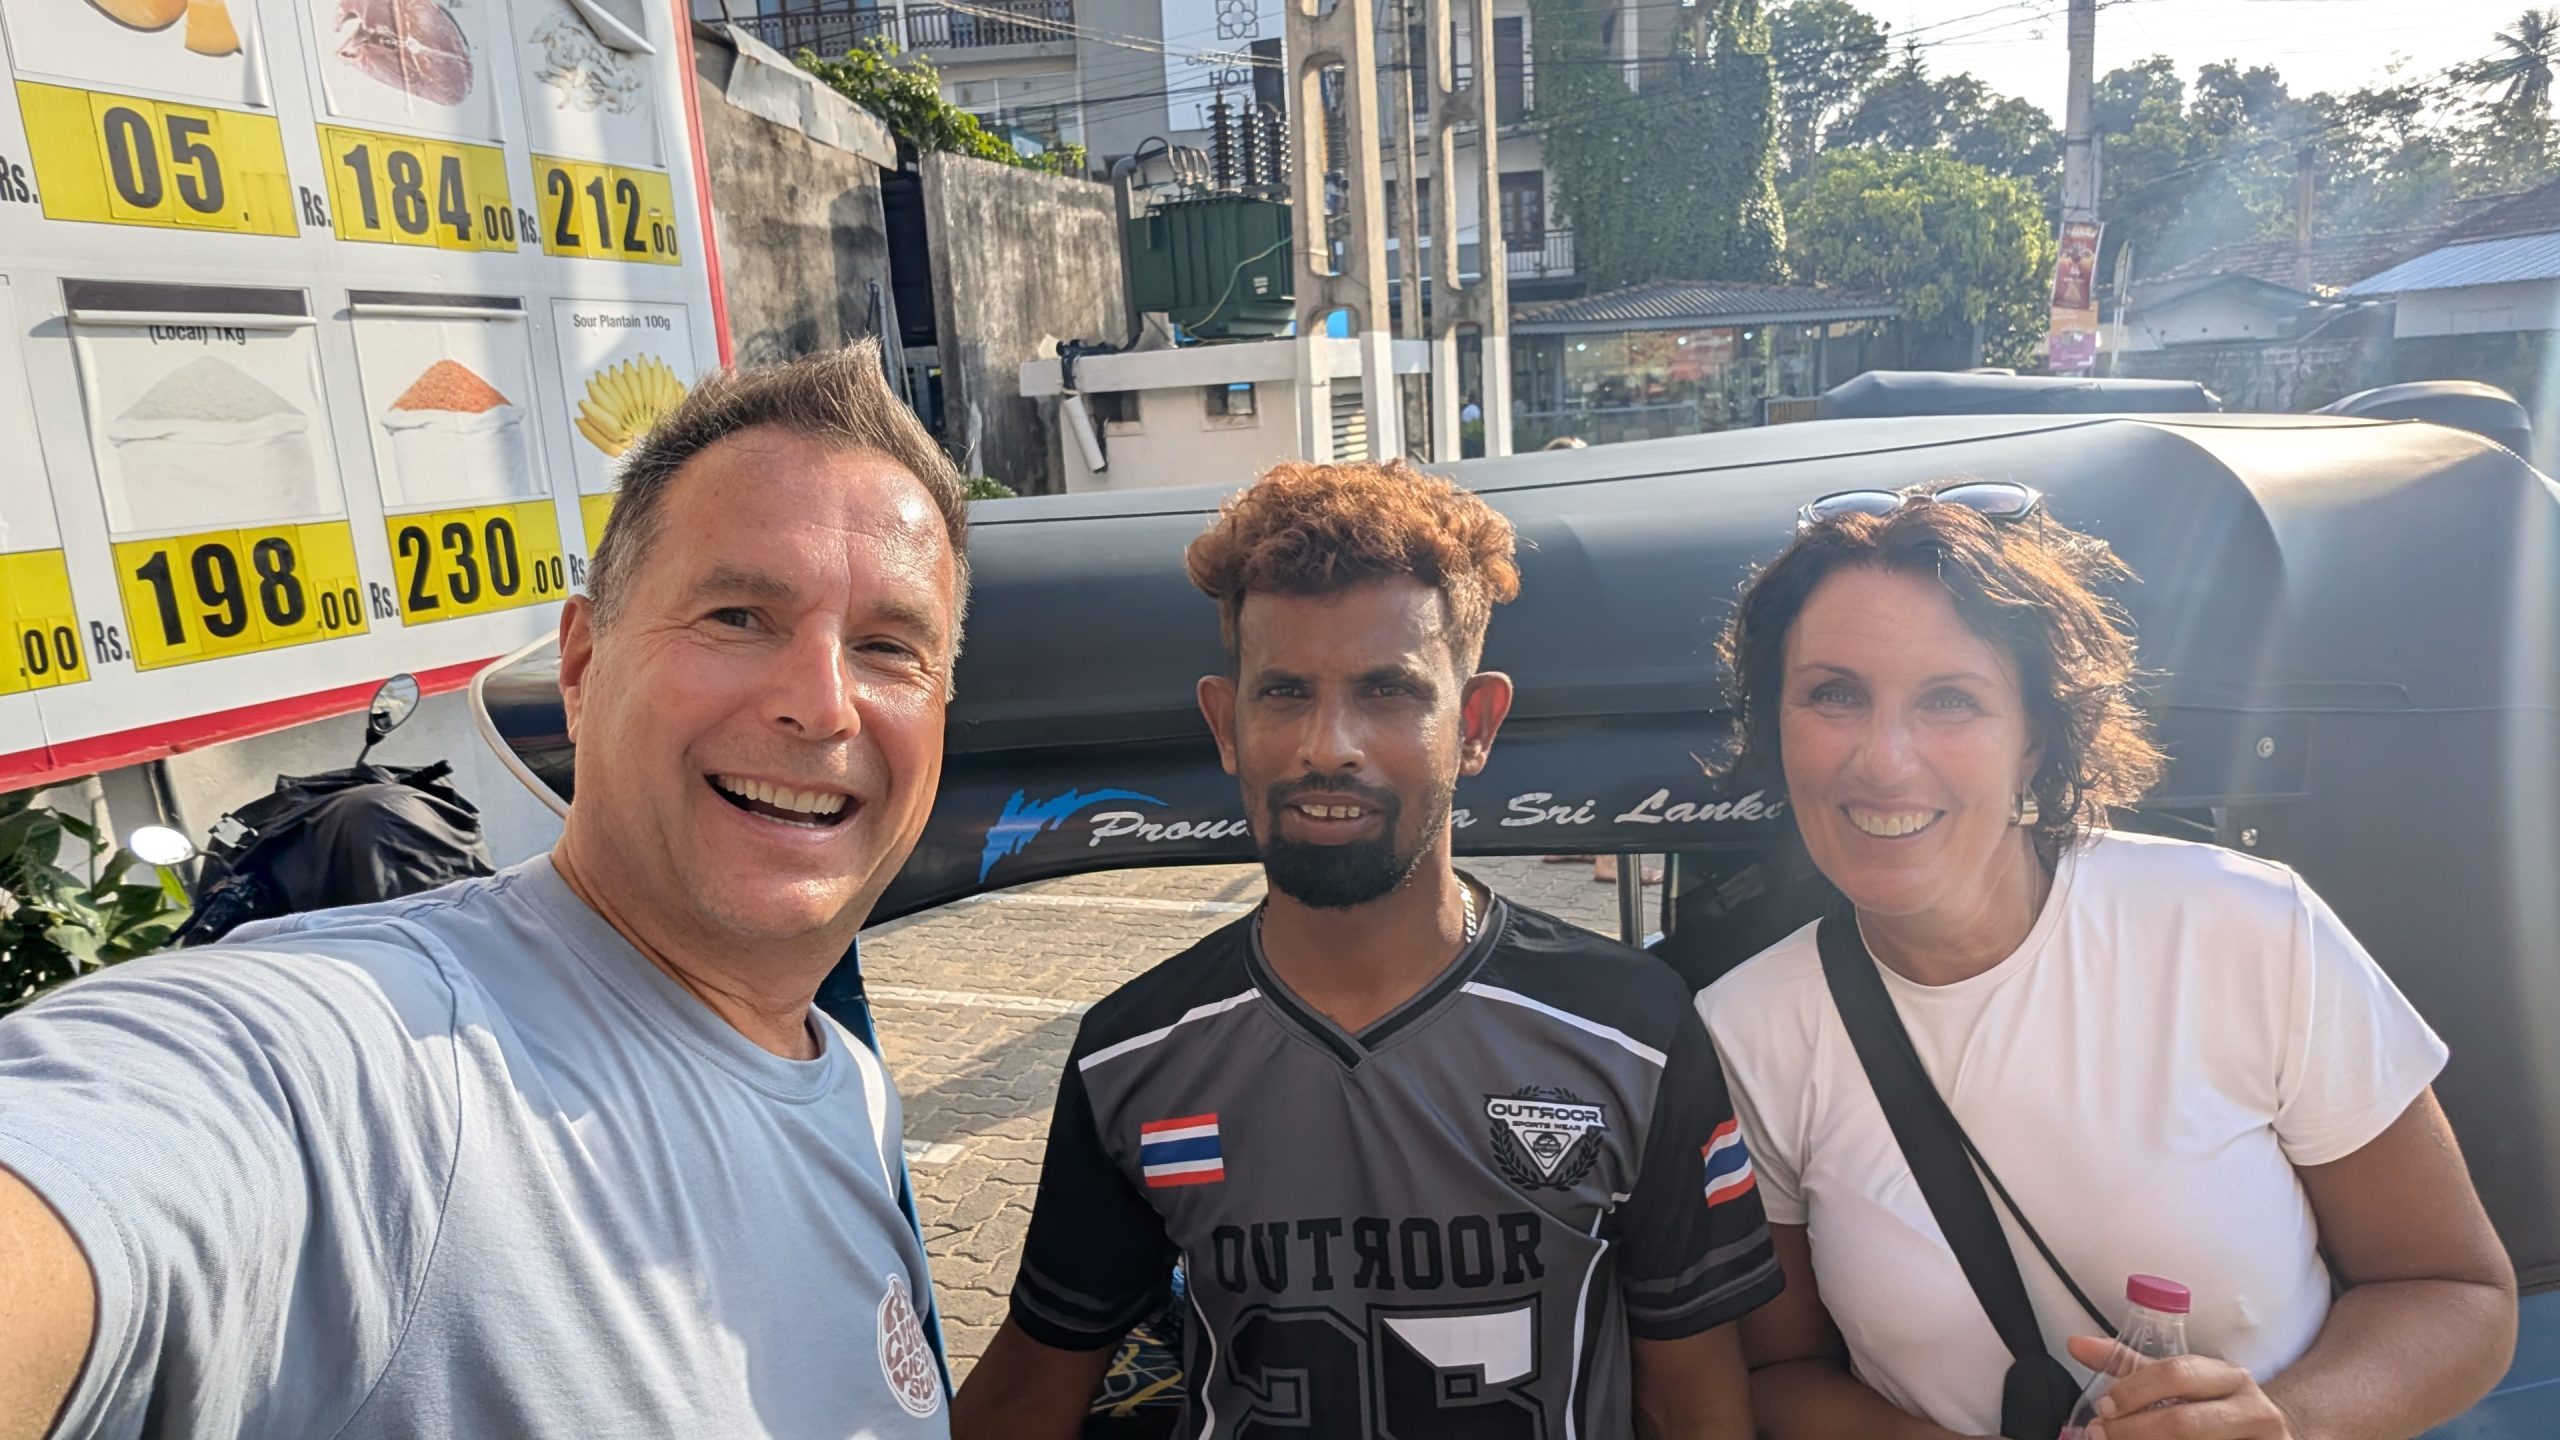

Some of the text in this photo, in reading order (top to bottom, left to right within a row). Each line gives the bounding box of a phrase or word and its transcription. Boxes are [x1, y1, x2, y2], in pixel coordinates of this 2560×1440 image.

[299, 186, 332, 228] Rs.
[518, 208, 542, 245] Rs.
[149, 325, 208, 345] (Local)
[573, 314, 671, 331] Sour Plantain 100g
[369, 582, 400, 620] Rs.
[89, 620, 131, 664] Rs.
[1500, 792, 1596, 827] Sri
[1512, 1121, 1582, 1131] SPORTS WEAR
